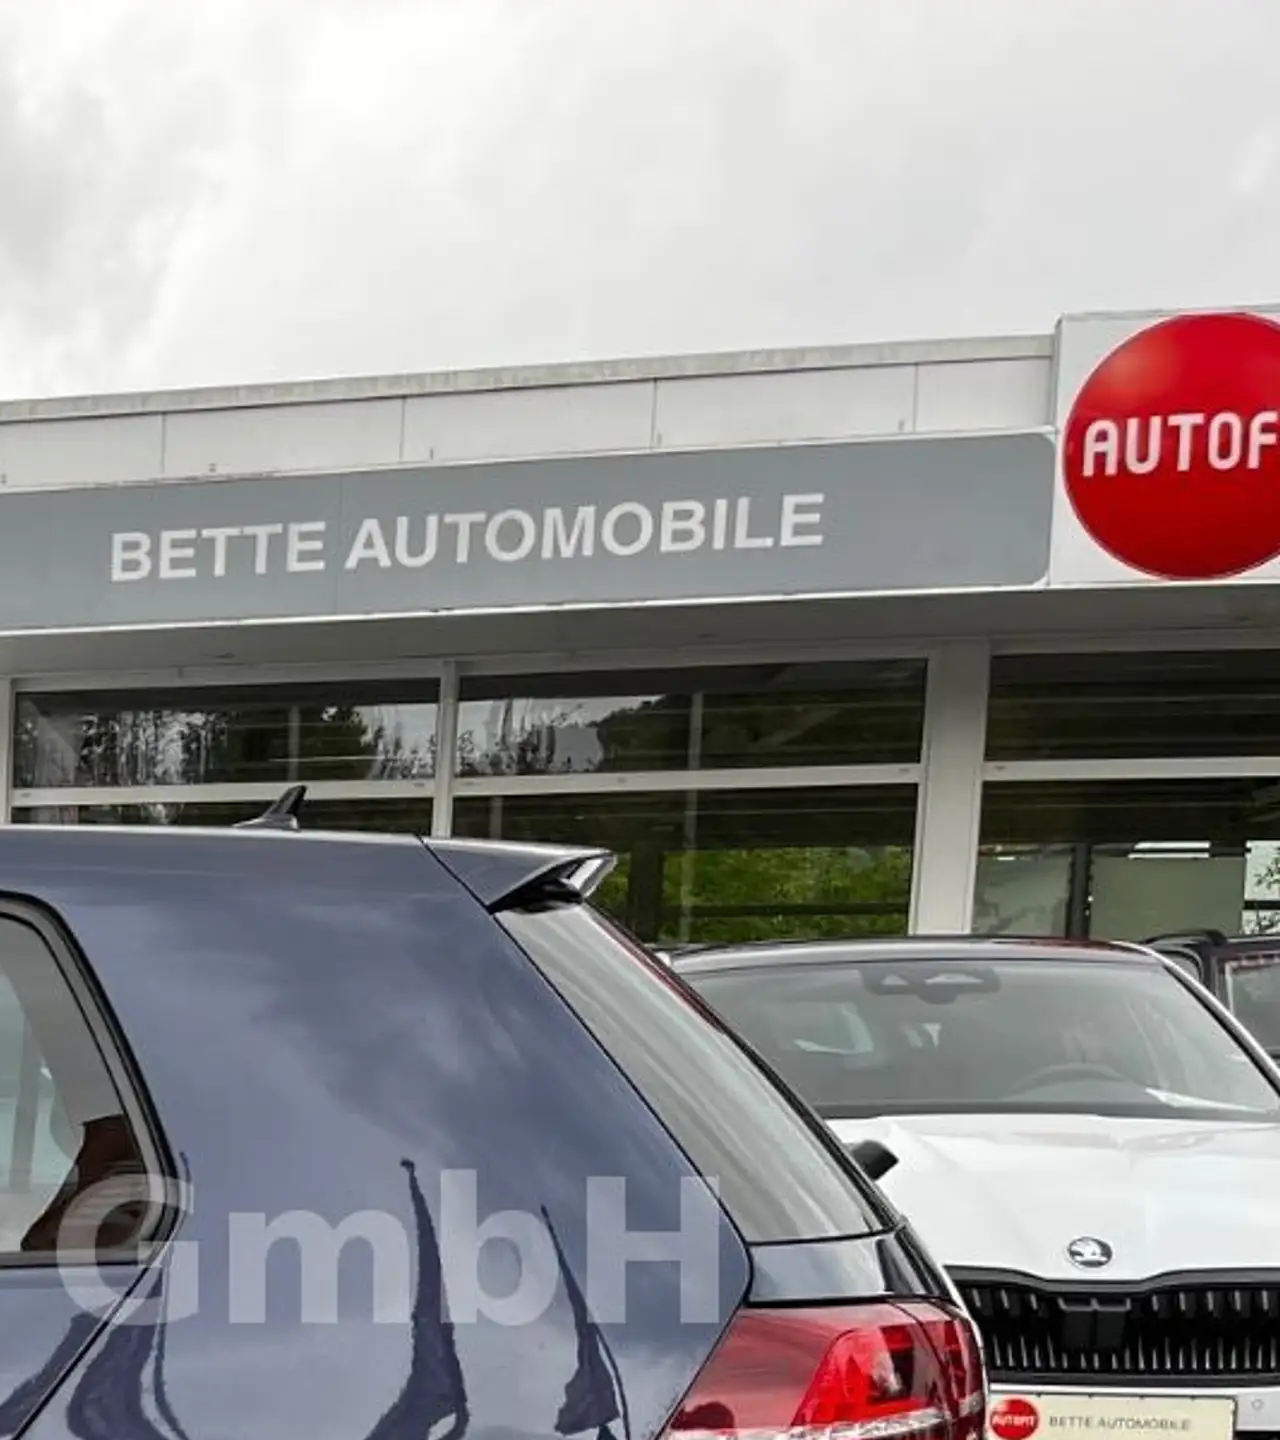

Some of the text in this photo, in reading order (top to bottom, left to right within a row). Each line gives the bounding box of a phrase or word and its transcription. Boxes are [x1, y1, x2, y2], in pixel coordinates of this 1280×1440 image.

[1082, 409, 1280, 477] AUTOF
[109, 492, 826, 582] BETTE AUTOMOBILE
[1048, 1415, 1192, 1431] BETTE AUTOMOBILE
